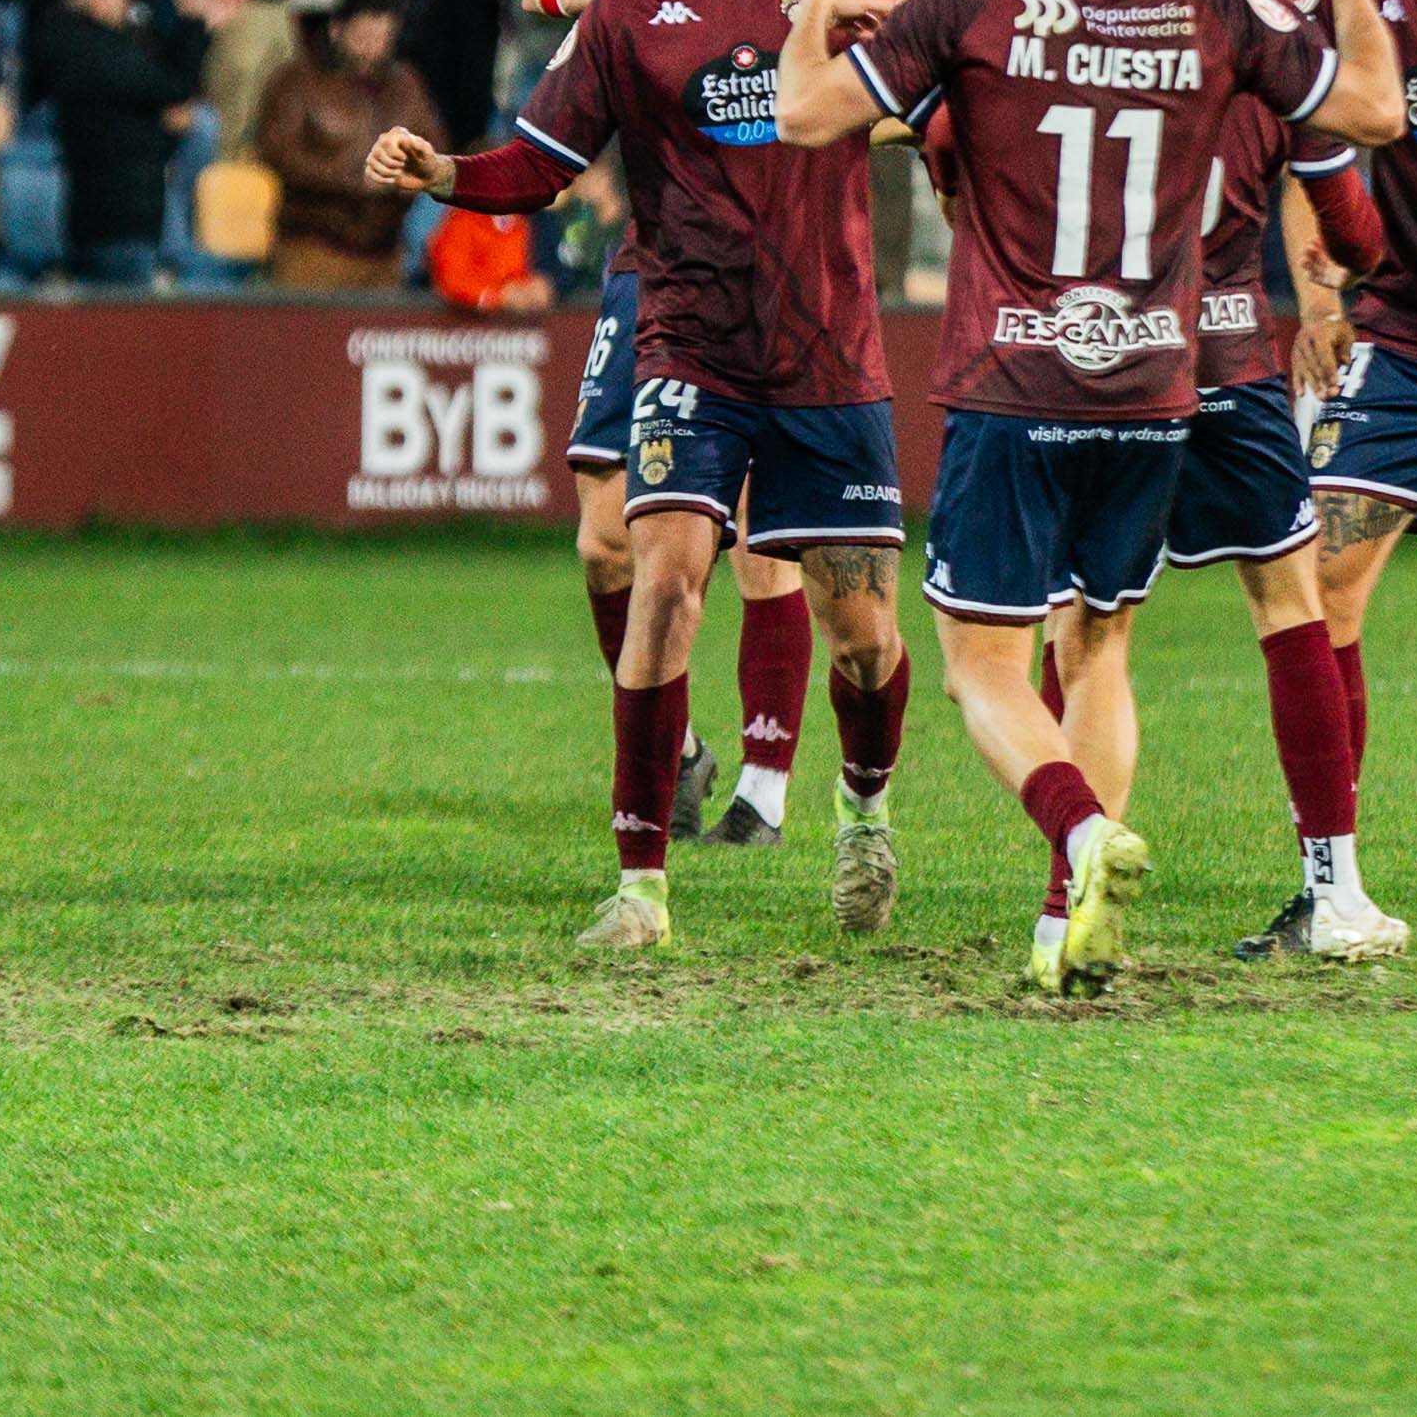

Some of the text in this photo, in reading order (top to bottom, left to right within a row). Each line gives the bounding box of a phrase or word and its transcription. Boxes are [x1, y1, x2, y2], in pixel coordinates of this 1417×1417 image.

[1082, 2, 1195, 24] Deputación
[1086, 21, 1195, 37] Pontevedra
[1007, 36, 1202, 91] M. CUESTA
[701, 69, 777, 98] Estrell
[706, 93, 776, 121] Galici
[1036, 104, 1163, 280] 11
[632, 378, 700, 420] 24
